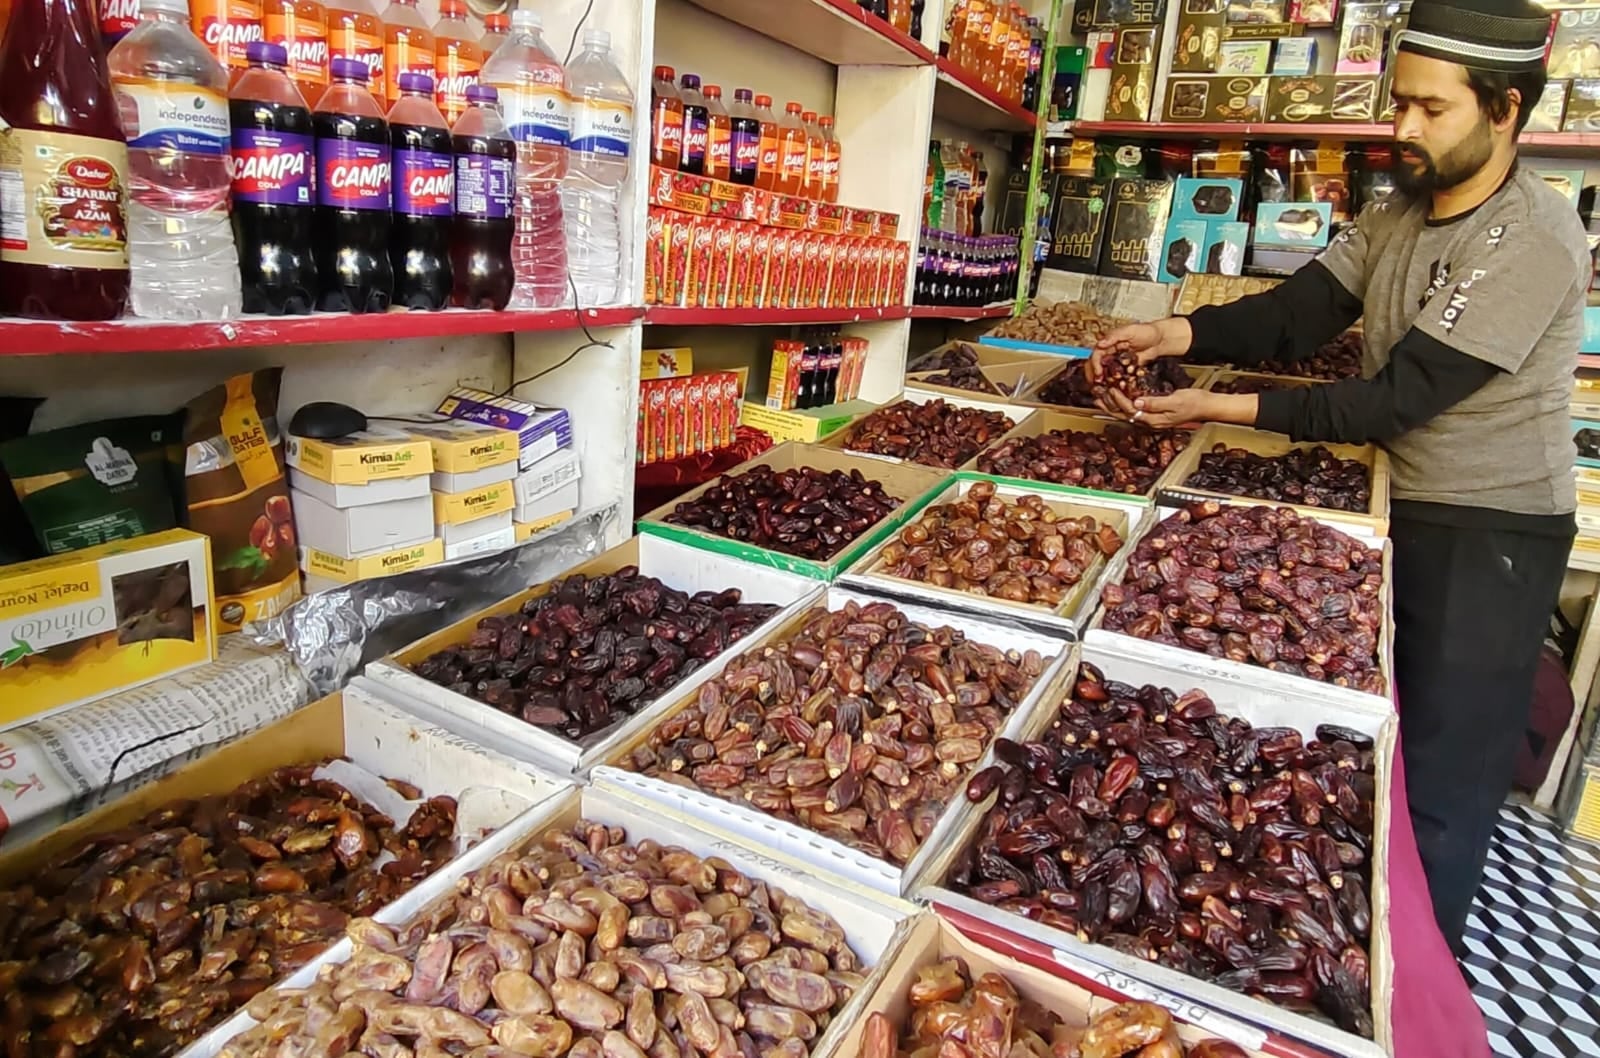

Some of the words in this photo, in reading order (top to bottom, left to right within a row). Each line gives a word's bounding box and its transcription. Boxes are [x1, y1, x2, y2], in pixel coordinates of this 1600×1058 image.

[232, 152, 304, 180] CAMPA
[257, 181, 281, 190] COLA
[61, 186, 118, 201] SHARBAT
[74, 209, 112, 222] AZAM
[230, 427, 261, 445] GULF
[233, 437, 265, 455] DATES
[470, 445, 493, 456] Kimia
[360, 453, 392, 465] Kimia
[464, 494, 487, 506] Kimia
[382, 553, 410, 568] Kimia
[44, 581, 89, 599] Deglet
[11, 605, 105, 641] Olinda
